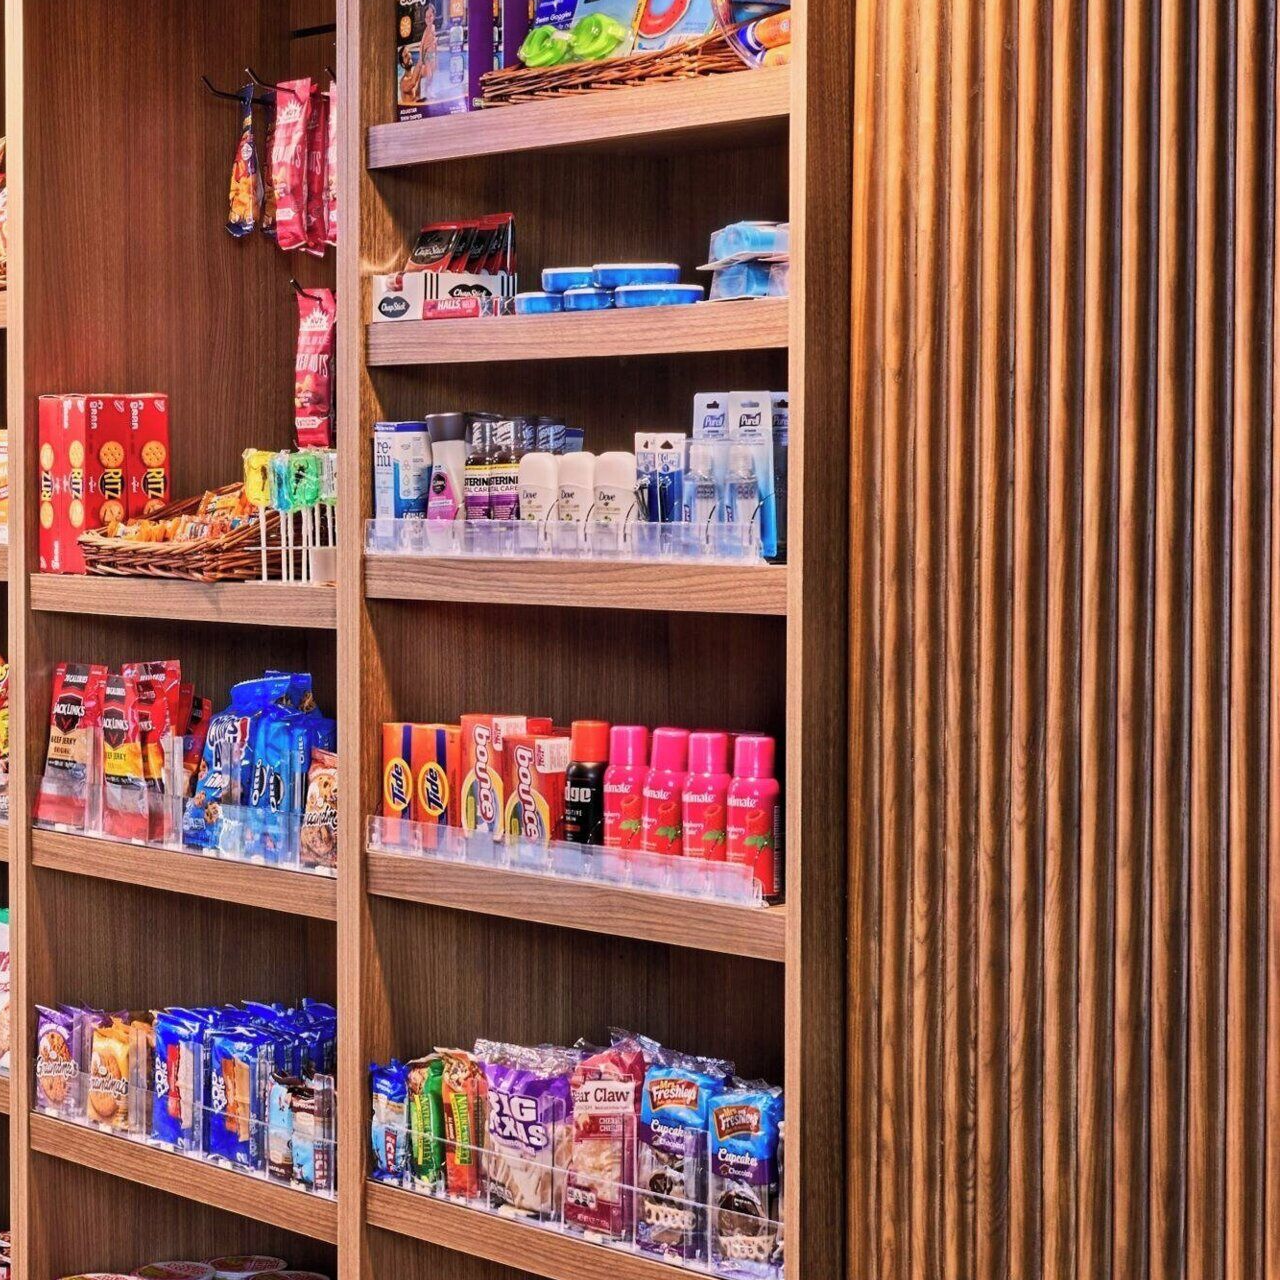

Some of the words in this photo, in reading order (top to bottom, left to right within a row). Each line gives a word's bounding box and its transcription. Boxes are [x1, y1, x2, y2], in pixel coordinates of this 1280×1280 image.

[550, 11, 572, 23] Goggles
[381, 302, 406, 313] ChapStick
[437, 300, 460, 311] HALLS
[41, 470, 53, 501] RITZ
[71, 468, 84, 500] RITZ
[104, 468, 123, 500] RITZ
[147, 468, 165, 499] RITZ
[523, 489, 537, 500] Dove
[560, 489, 575, 500] Dove
[599, 490, 616, 502] Dove
[62, 736, 76, 745] JERKY
[391, 763, 407, 805] Tide
[475, 725, 494, 822] bounce
[426, 767, 443, 811] Tide
[515, 746, 540, 842] bounce
[37, 1055, 79, 1080] Grandma's
[594, 1087, 629, 1102] Claw
[717, 1148, 758, 1166] Cupcakes
